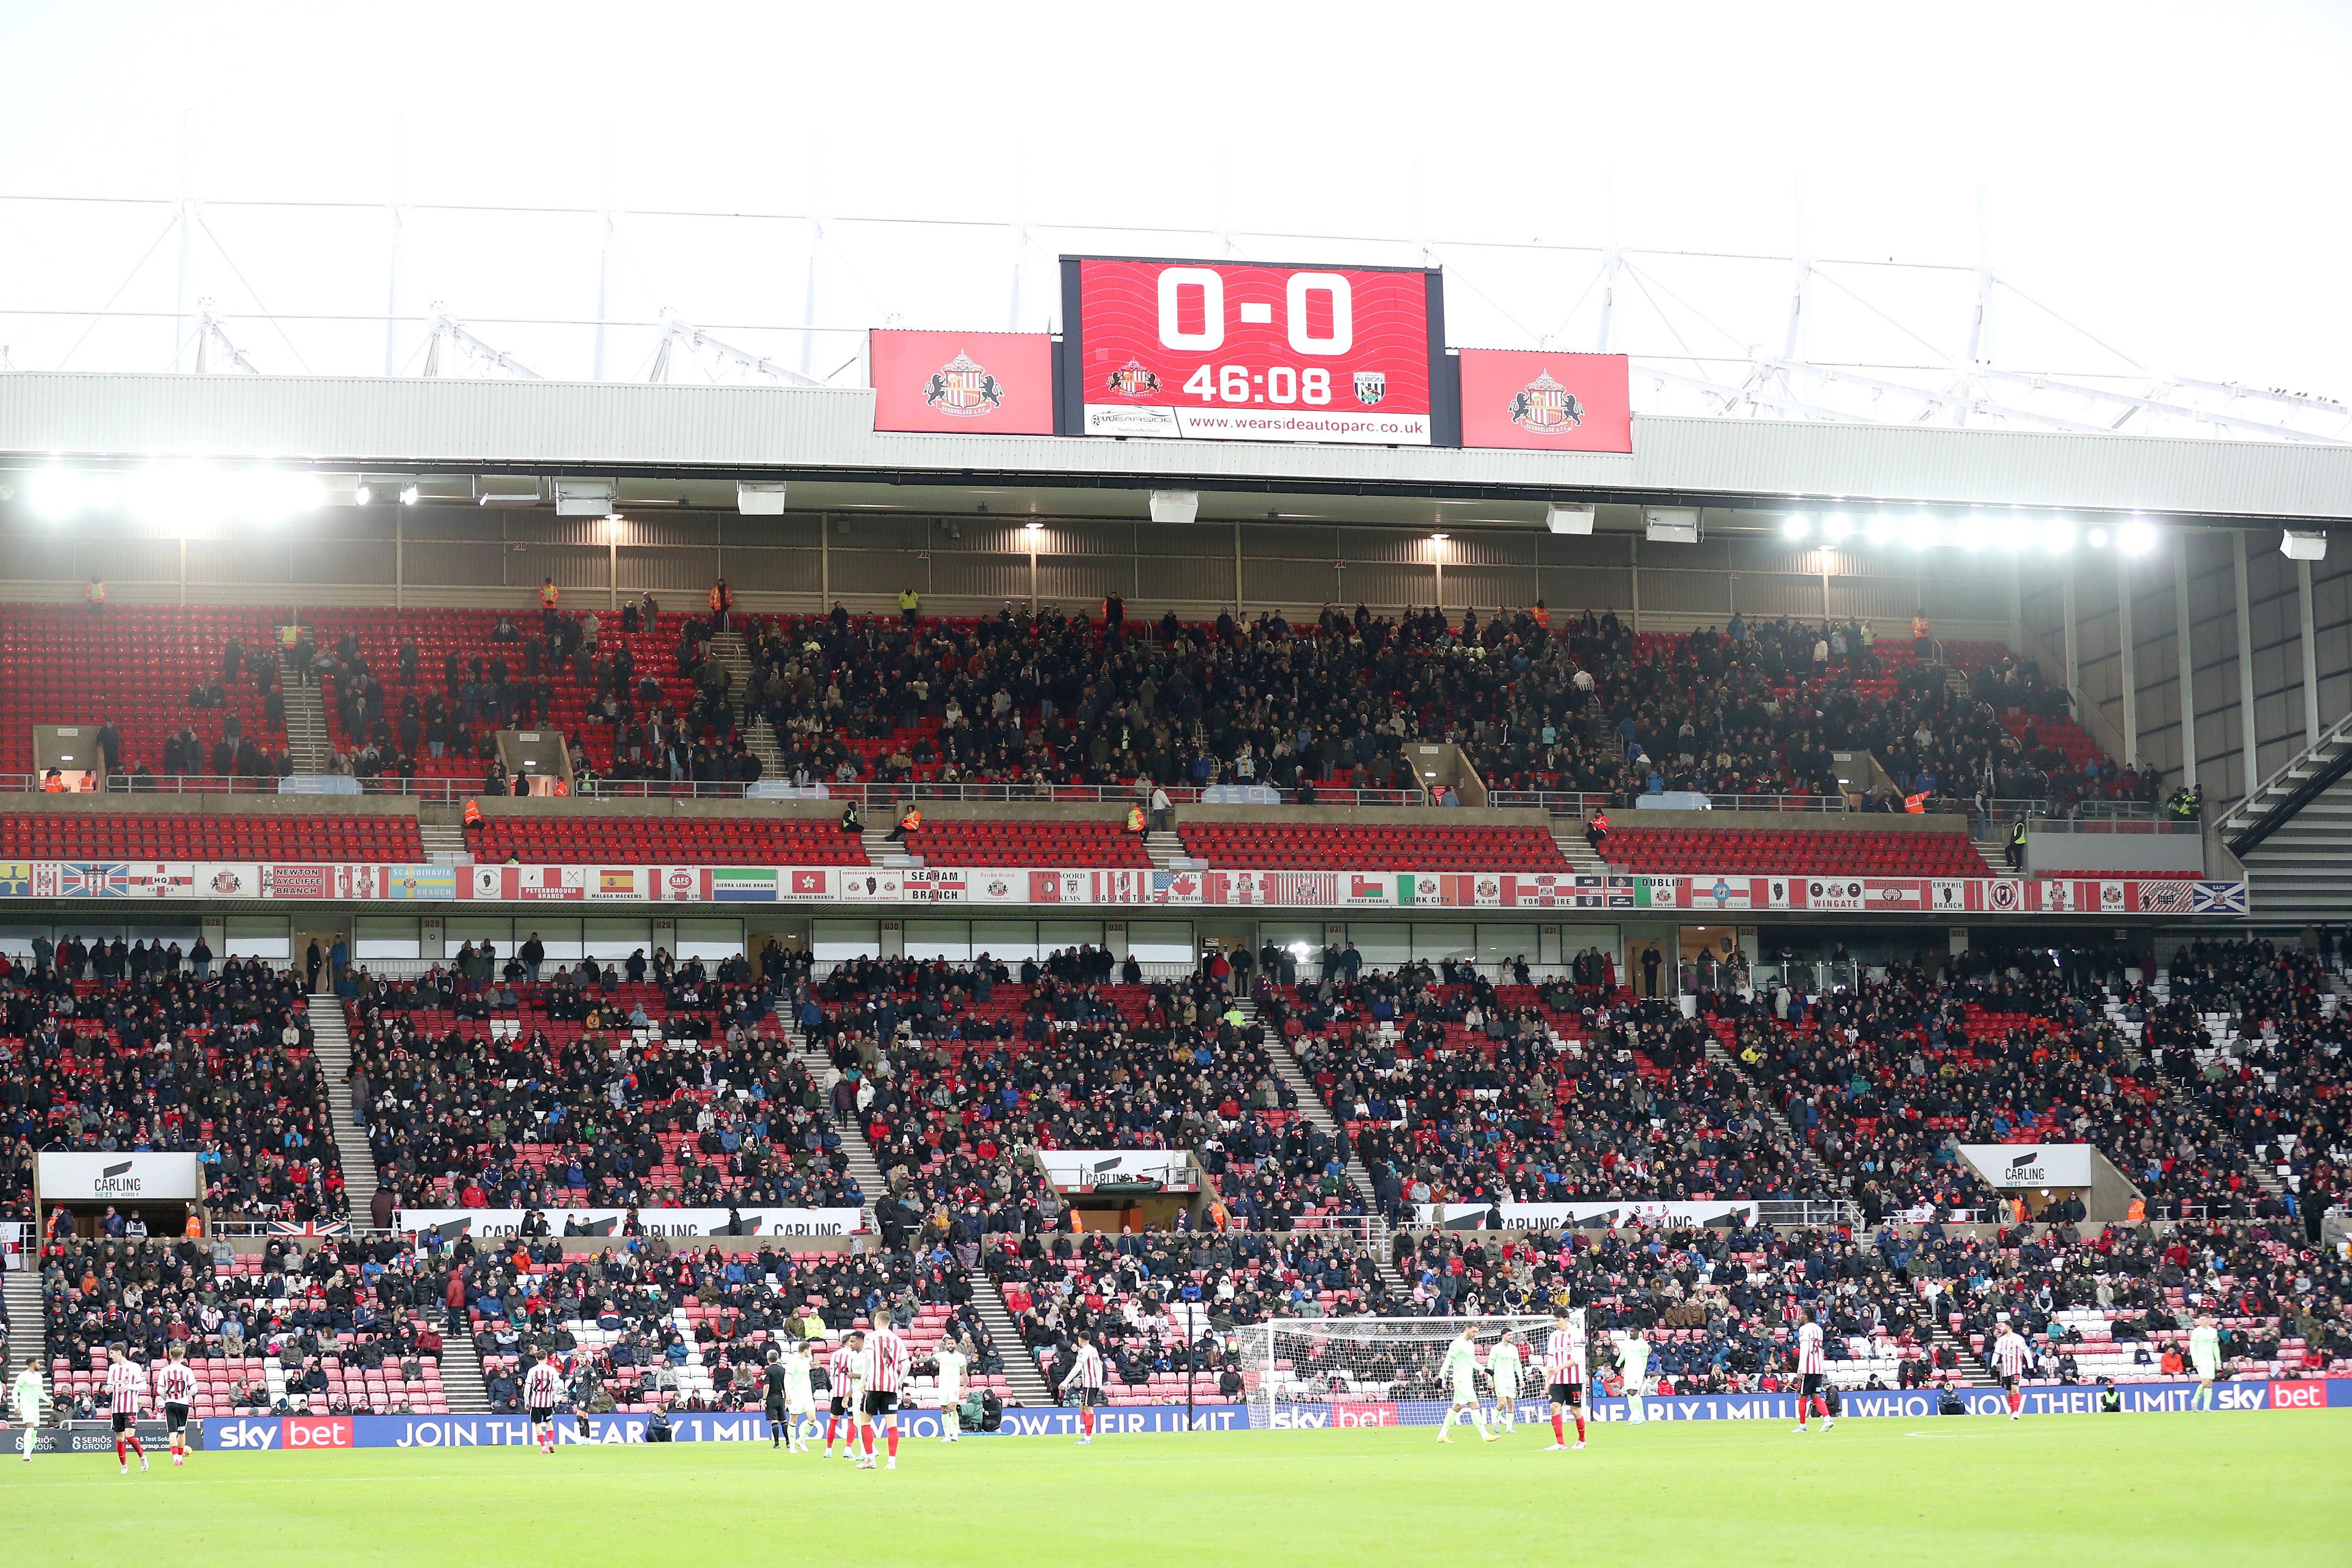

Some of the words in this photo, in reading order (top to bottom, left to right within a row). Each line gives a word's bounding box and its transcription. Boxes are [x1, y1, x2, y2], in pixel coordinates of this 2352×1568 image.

[1157, 267, 1225, 351] 0
[1240, 303, 1271, 323] -
[1286, 272, 1353, 355] 0
[1182, 364, 1332, 405] 46:08
[942, 406, 972, 415] SUNDERLAND
[1189, 417, 1423, 434] www.wearsideautoparc.co.uk
[1526, 424, 1555, 433] SUNDERLAND
[475, 869, 489, 878] NORTHERN
[489, 869, 499, 879] IRELAND
[911, 872, 958, 880] SEAHAM
[475, 888, 493, 896] SUPPORTERS
[912, 891, 958, 899] BRANCH
[2149, 885, 2165, 896] COXHOE
[2165, 885, 2184, 896] BRANCH
[2005, 1169, 2045, 1180] CARLING
[94, 1178, 141, 1191] CARLING
[1635, 1205, 1641, 1214] S
[774, 1223, 842, 1236] CARLING
[883, 1347, 892, 1367] 5
[165, 1379, 185, 1394] 20
[533, 1378, 552, 1391] 22
[2120, 1390, 2191, 1413] LIMIT
[2218, 1384, 2266, 1410] sky
[2275, 1384, 2321, 1407] bet
[1706, 1402, 1717, 1420] 1
[1855, 1396, 1929, 1418] WHO
[1937, 1394, 2027, 1415] NOW
[1055, 1413, 1145, 1434] THEIR
[1274, 1406, 1328, 1429] sky
[1340, 1406, 1390, 1428] bet
[220, 1420, 278, 1450] sky
[289, 1420, 346, 1446] bet
[396, 1422, 477, 1447] JOIN
[691, 1420, 703, 1442] 1
